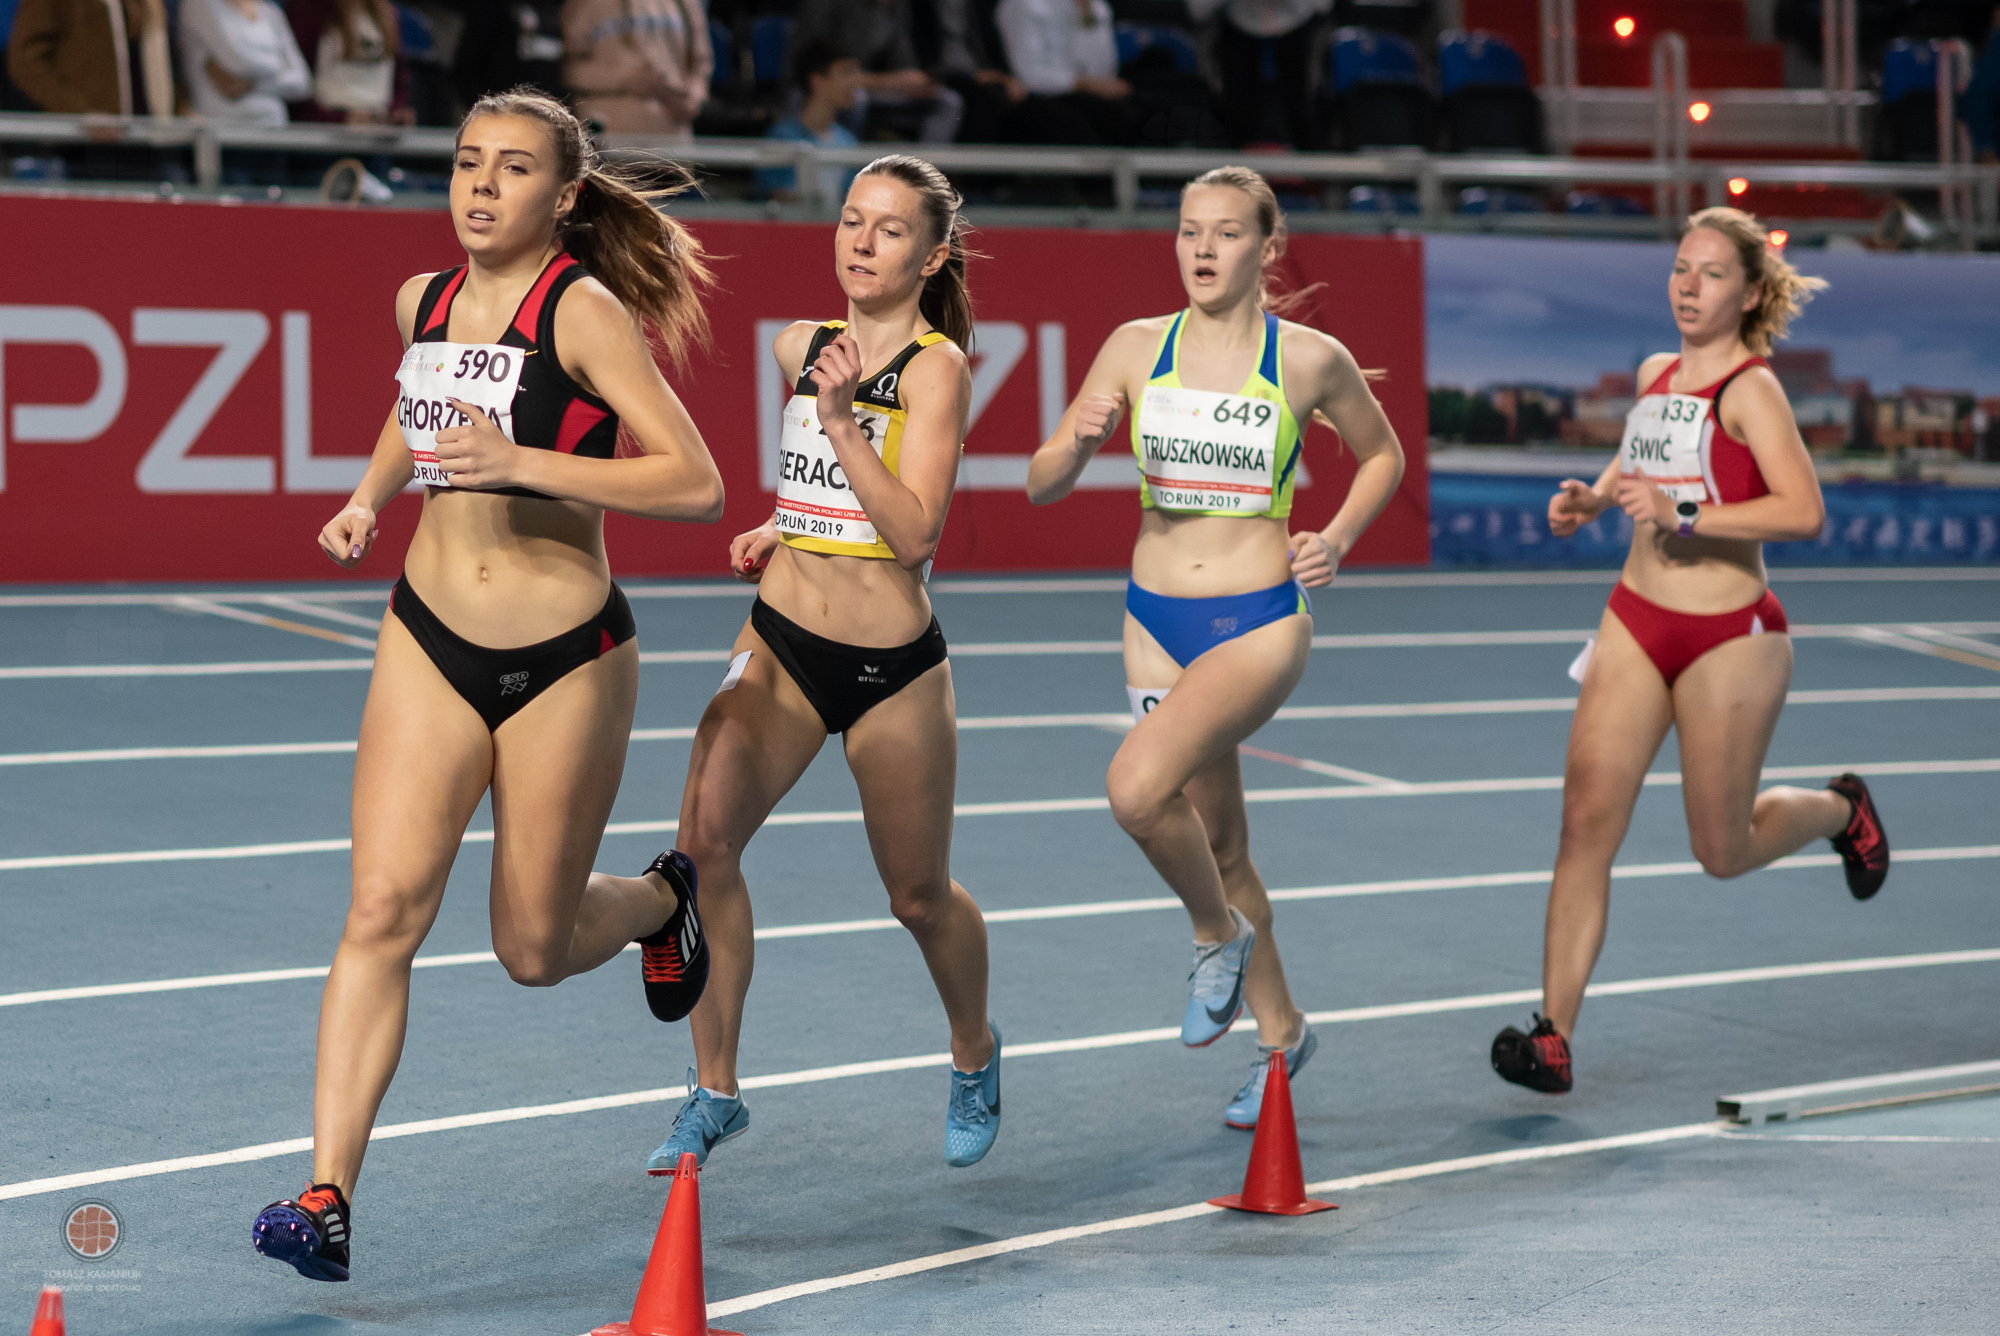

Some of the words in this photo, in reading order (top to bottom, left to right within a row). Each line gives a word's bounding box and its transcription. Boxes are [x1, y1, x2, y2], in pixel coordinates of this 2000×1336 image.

[454, 349, 511, 383] 590
[1213, 399, 1272, 428] 649
[1142, 434, 1266, 472] TRUSZKOWSKA
[1630, 432, 1672, 462] ŚWIĆ
[821, 509, 843, 517] POLSKI
[1160, 490, 1204, 506] TORUŃ
[1208, 494, 1241, 508] 2019
[775, 512, 807, 531] ORUŃ
[810, 519, 844, 536] 2019
